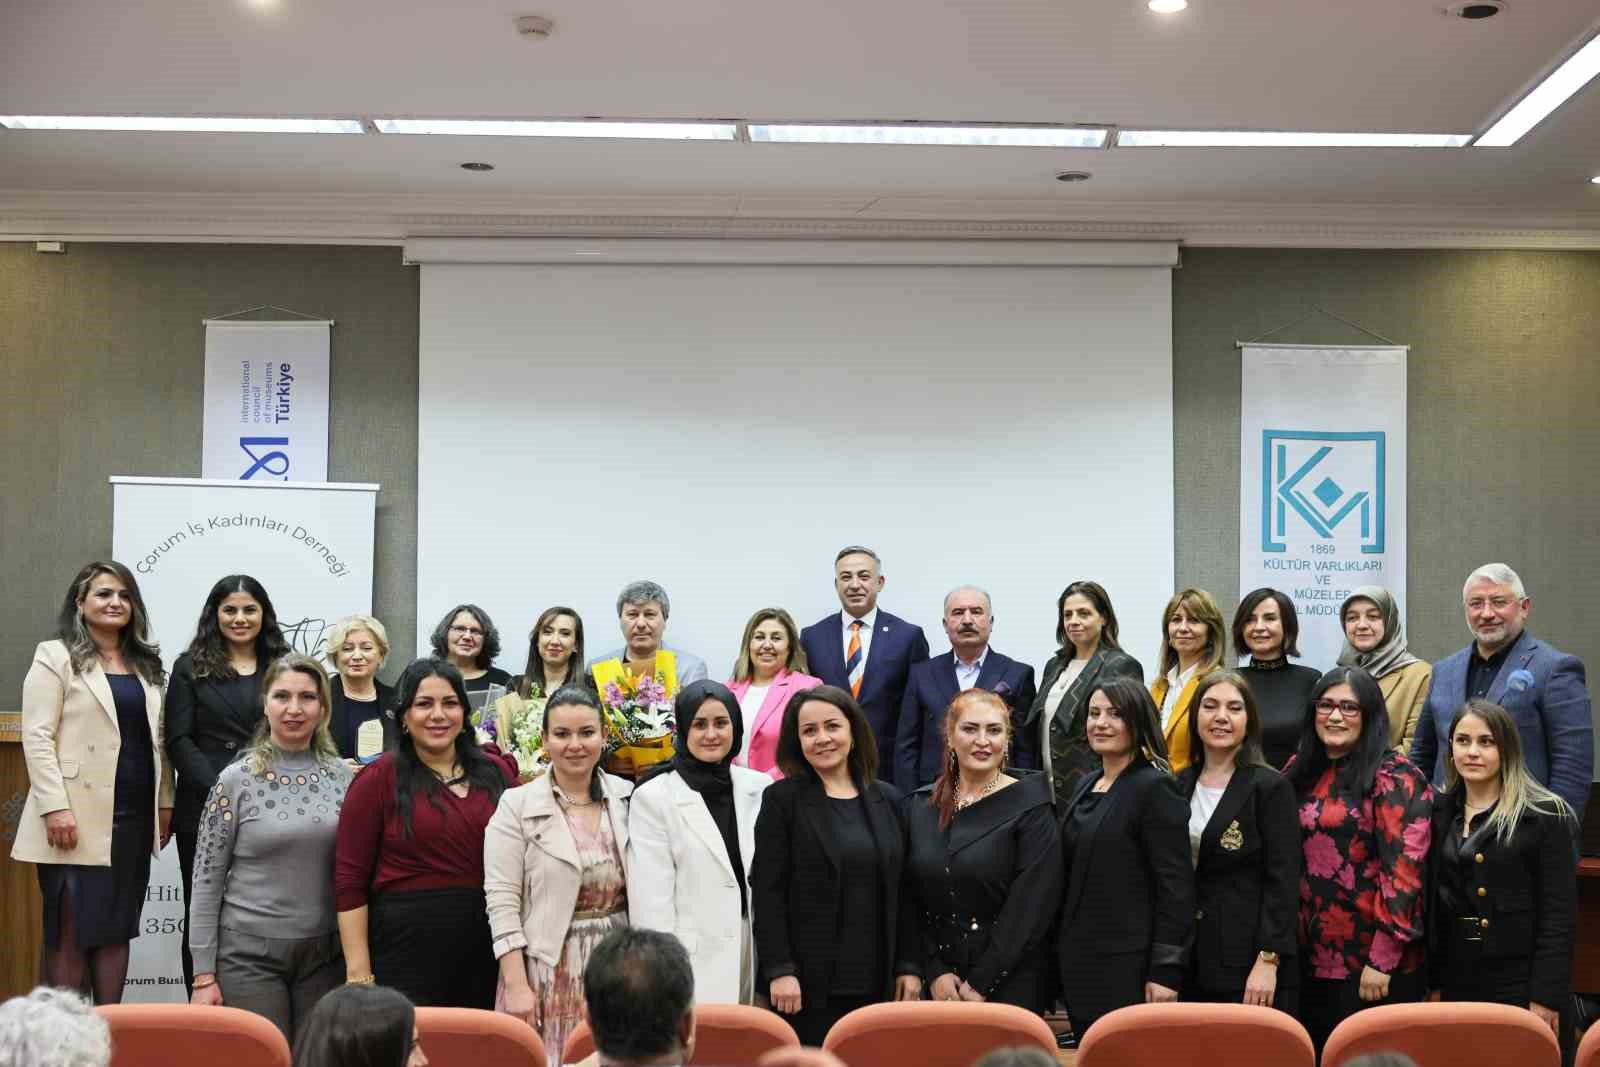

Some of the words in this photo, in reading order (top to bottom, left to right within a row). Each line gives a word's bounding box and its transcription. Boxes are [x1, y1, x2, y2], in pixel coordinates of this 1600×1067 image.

[241, 360, 250, 423] international
[252, 386, 261, 423] council
[275, 362, 294, 424] Türkiye
[136, 530, 187, 575] Çorum
[207, 513, 289, 534] Kadınları
[291, 526, 351, 578] Derneği
[1310, 544, 1336, 554] 1869
[1263, 558, 1311, 570] KÜLTÜR
[1313, 560, 1382, 572] VARLIKLARI
[1315, 575, 1331, 585] VE
